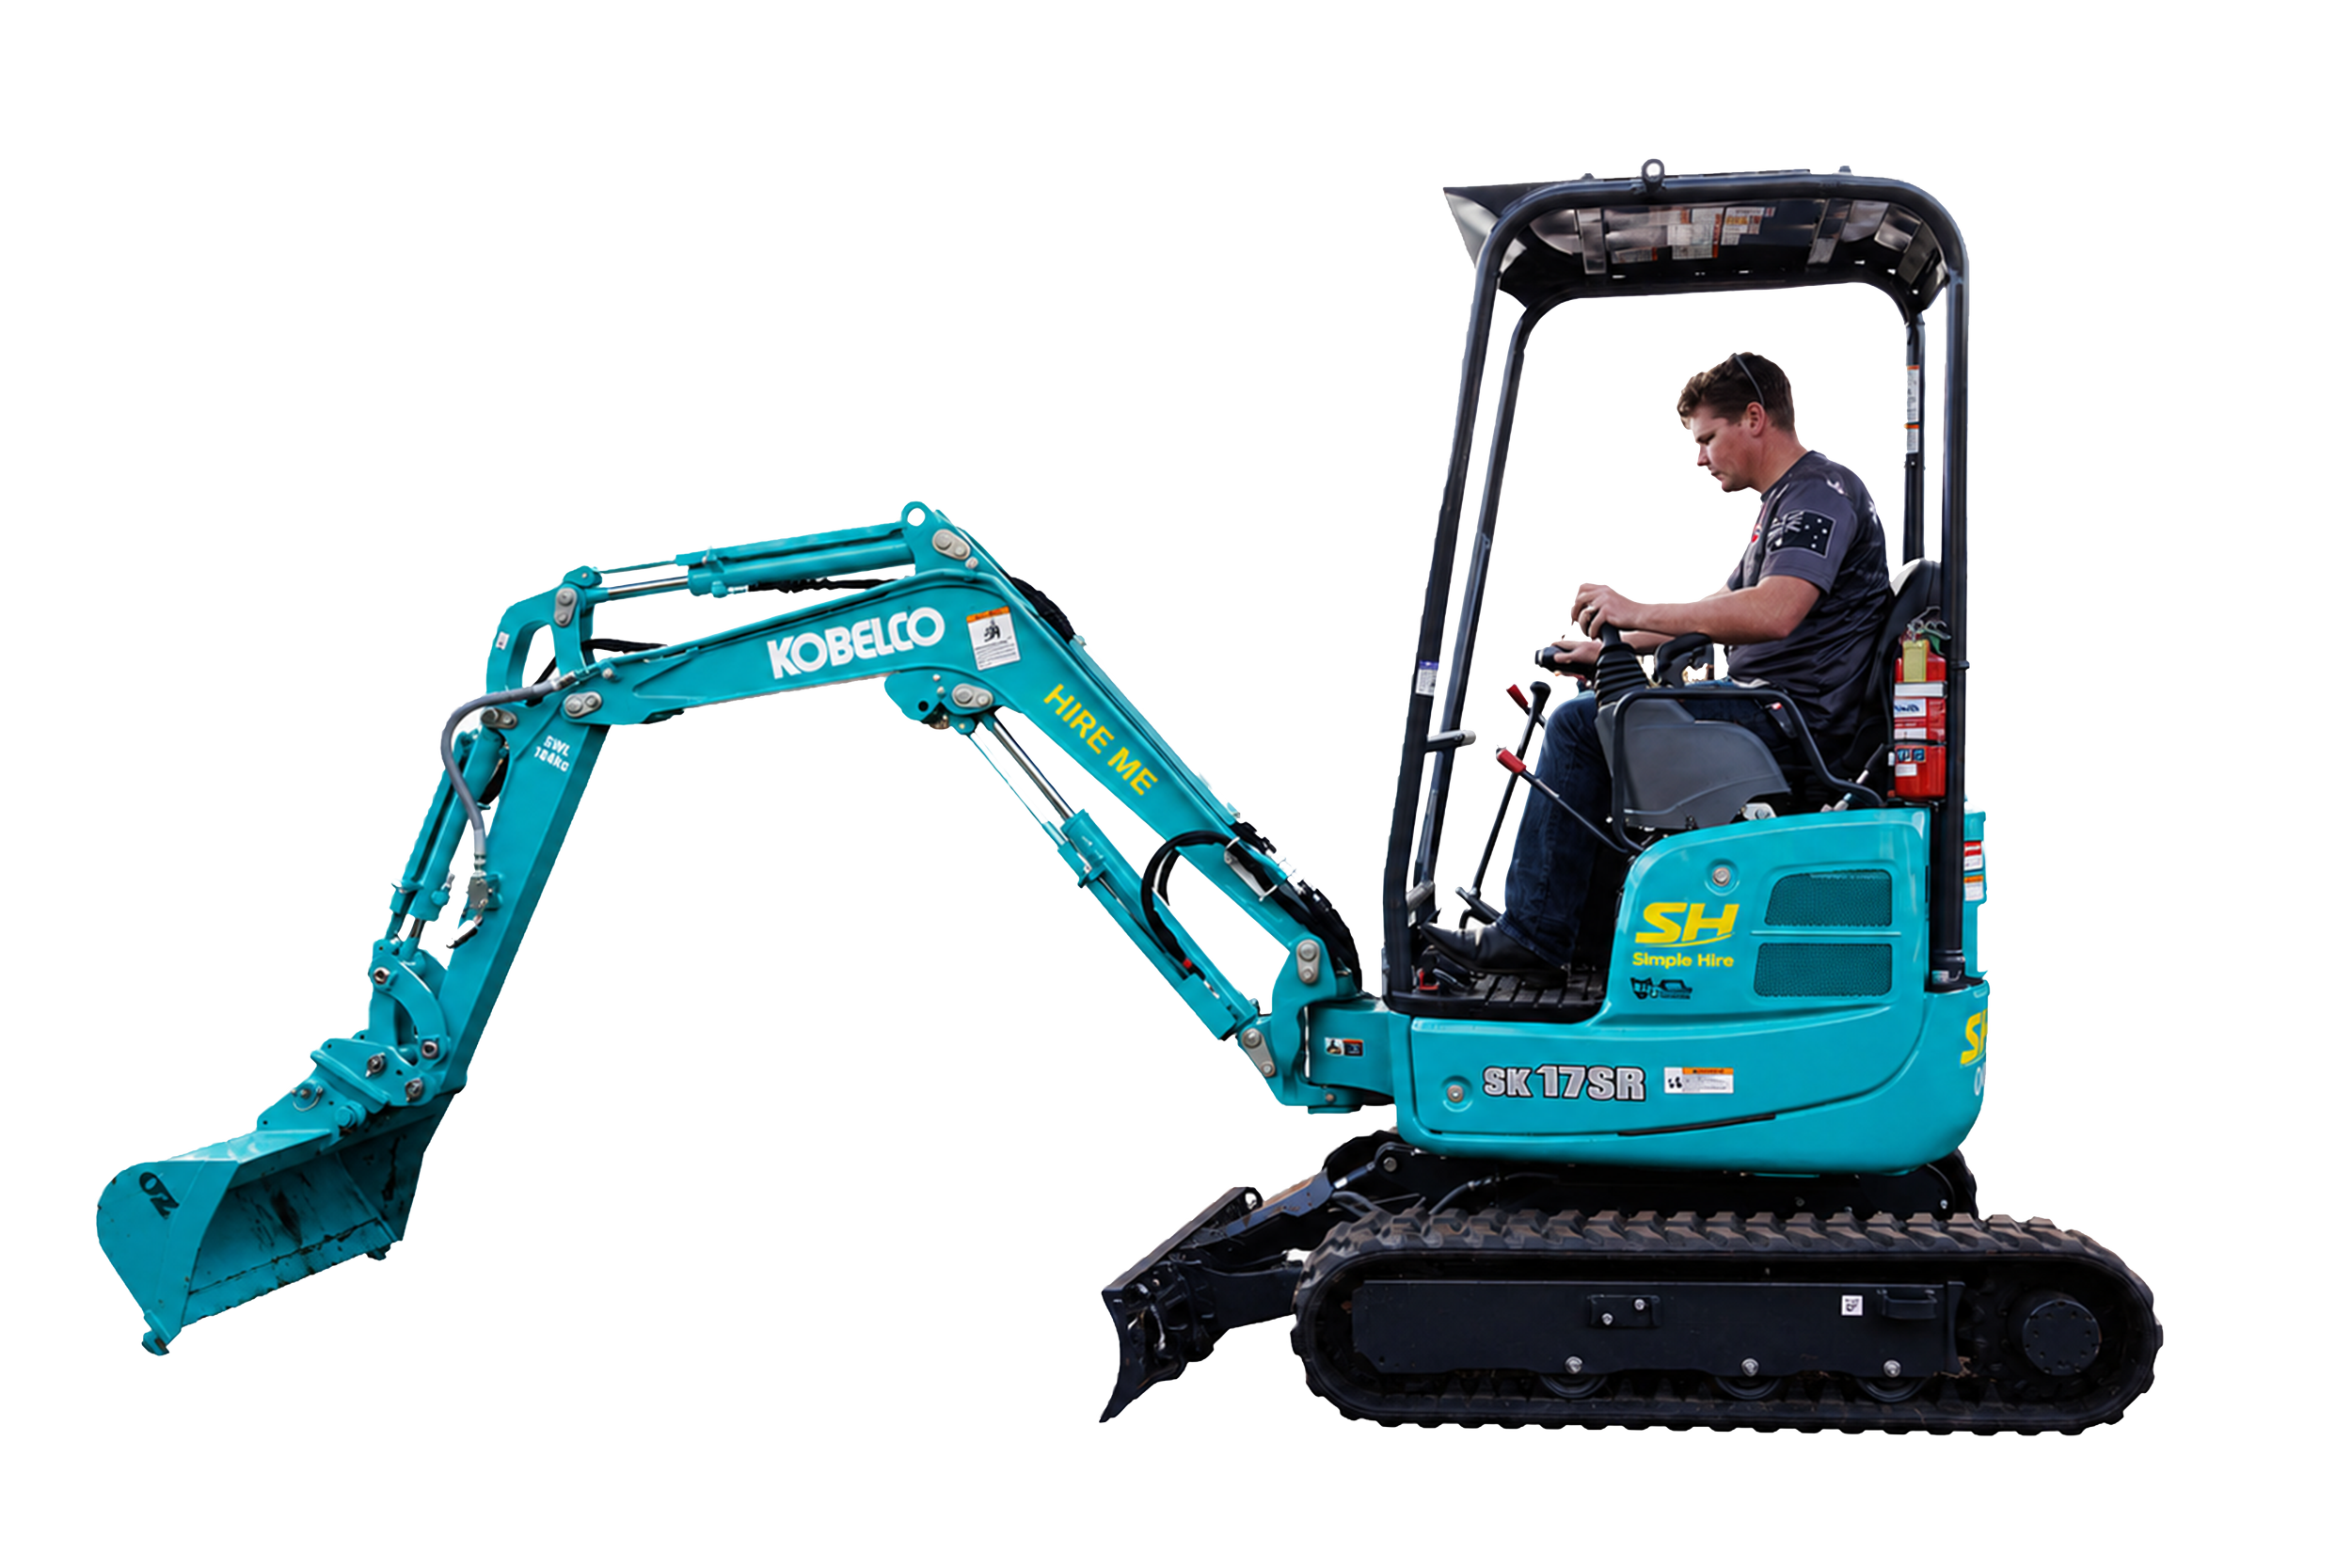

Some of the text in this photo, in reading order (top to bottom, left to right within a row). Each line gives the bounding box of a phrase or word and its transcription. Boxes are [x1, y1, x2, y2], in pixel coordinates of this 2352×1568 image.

[767, 607, 946, 679] KOBELCO
[1043, 684, 1158, 796] HIRE ME
[1635, 902, 1740, 943] SH
[1632, 952, 1735, 970] Simple Hire
[139, 1171, 180, 1221] OZ
